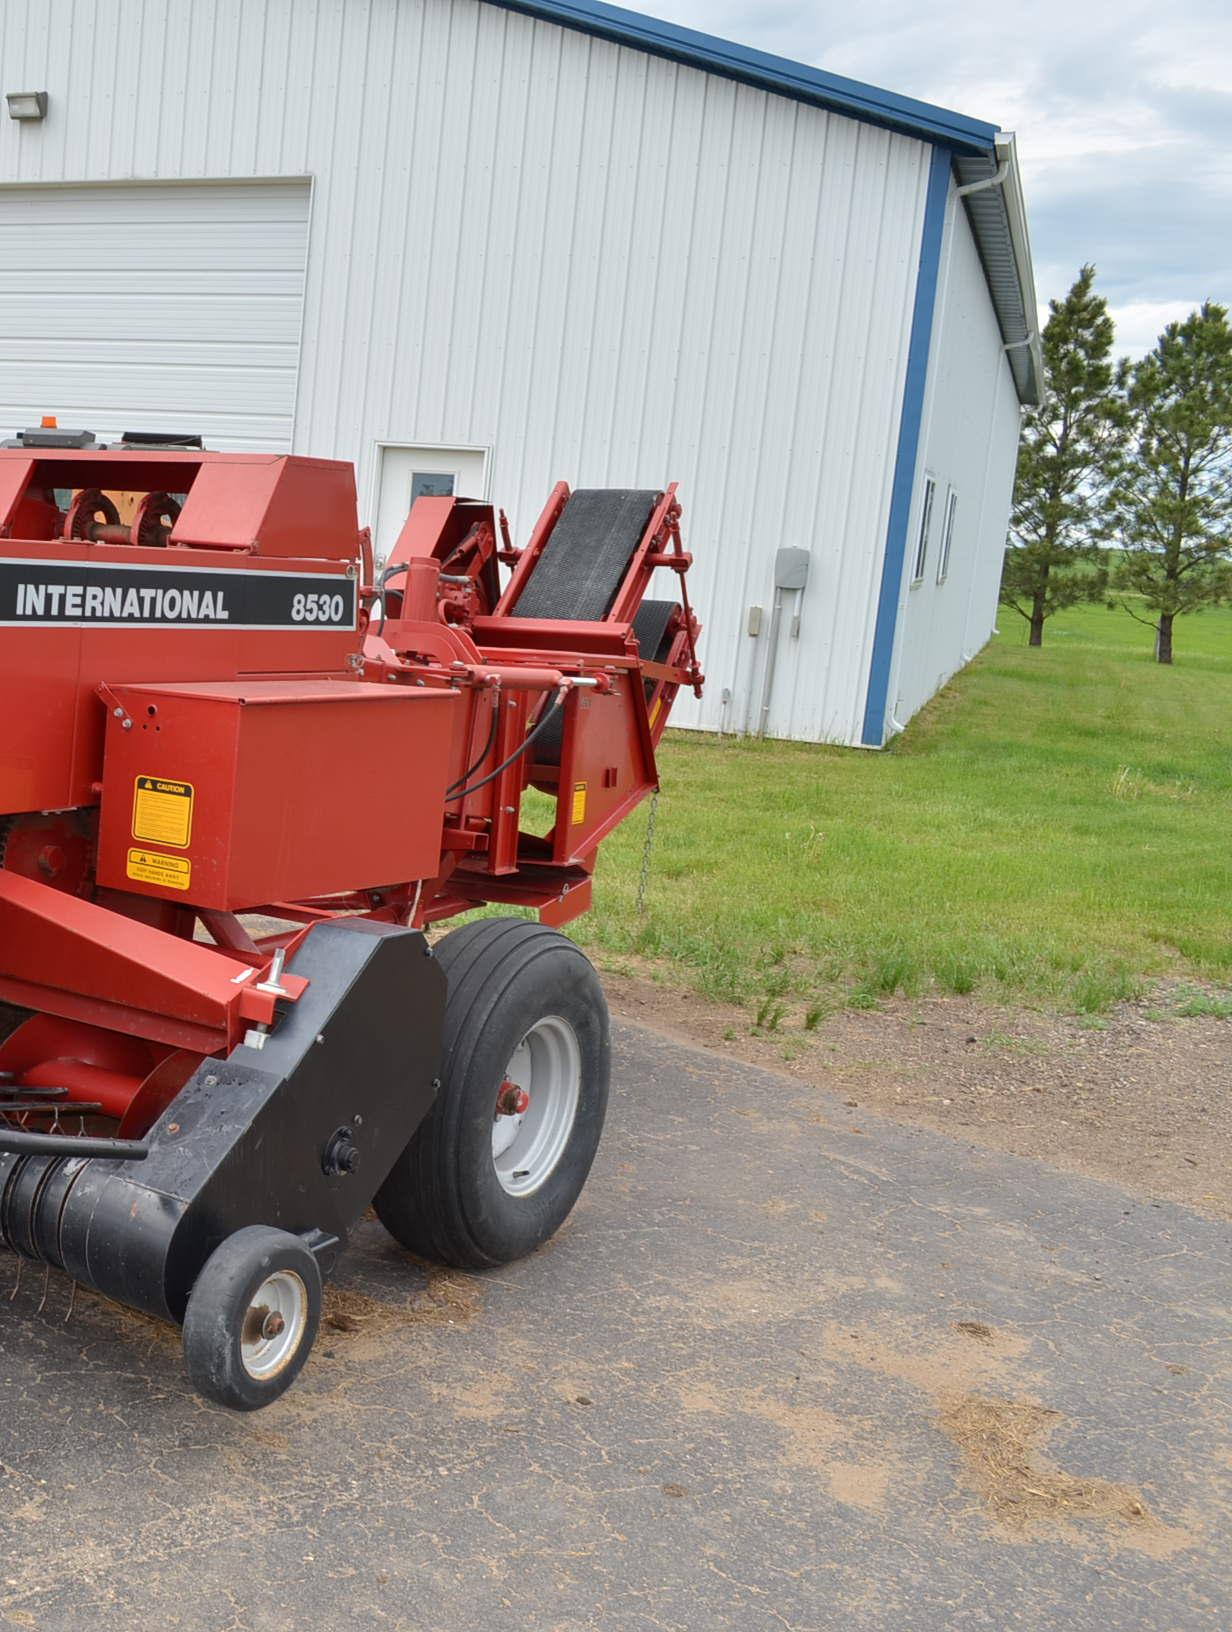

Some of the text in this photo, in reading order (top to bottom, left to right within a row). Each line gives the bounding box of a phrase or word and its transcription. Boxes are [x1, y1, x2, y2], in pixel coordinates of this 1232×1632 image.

[16, 583, 229, 620] INTERNATIONAL
[291, 593, 344, 622] 8530
[156, 782, 185, 794] CAUTION
